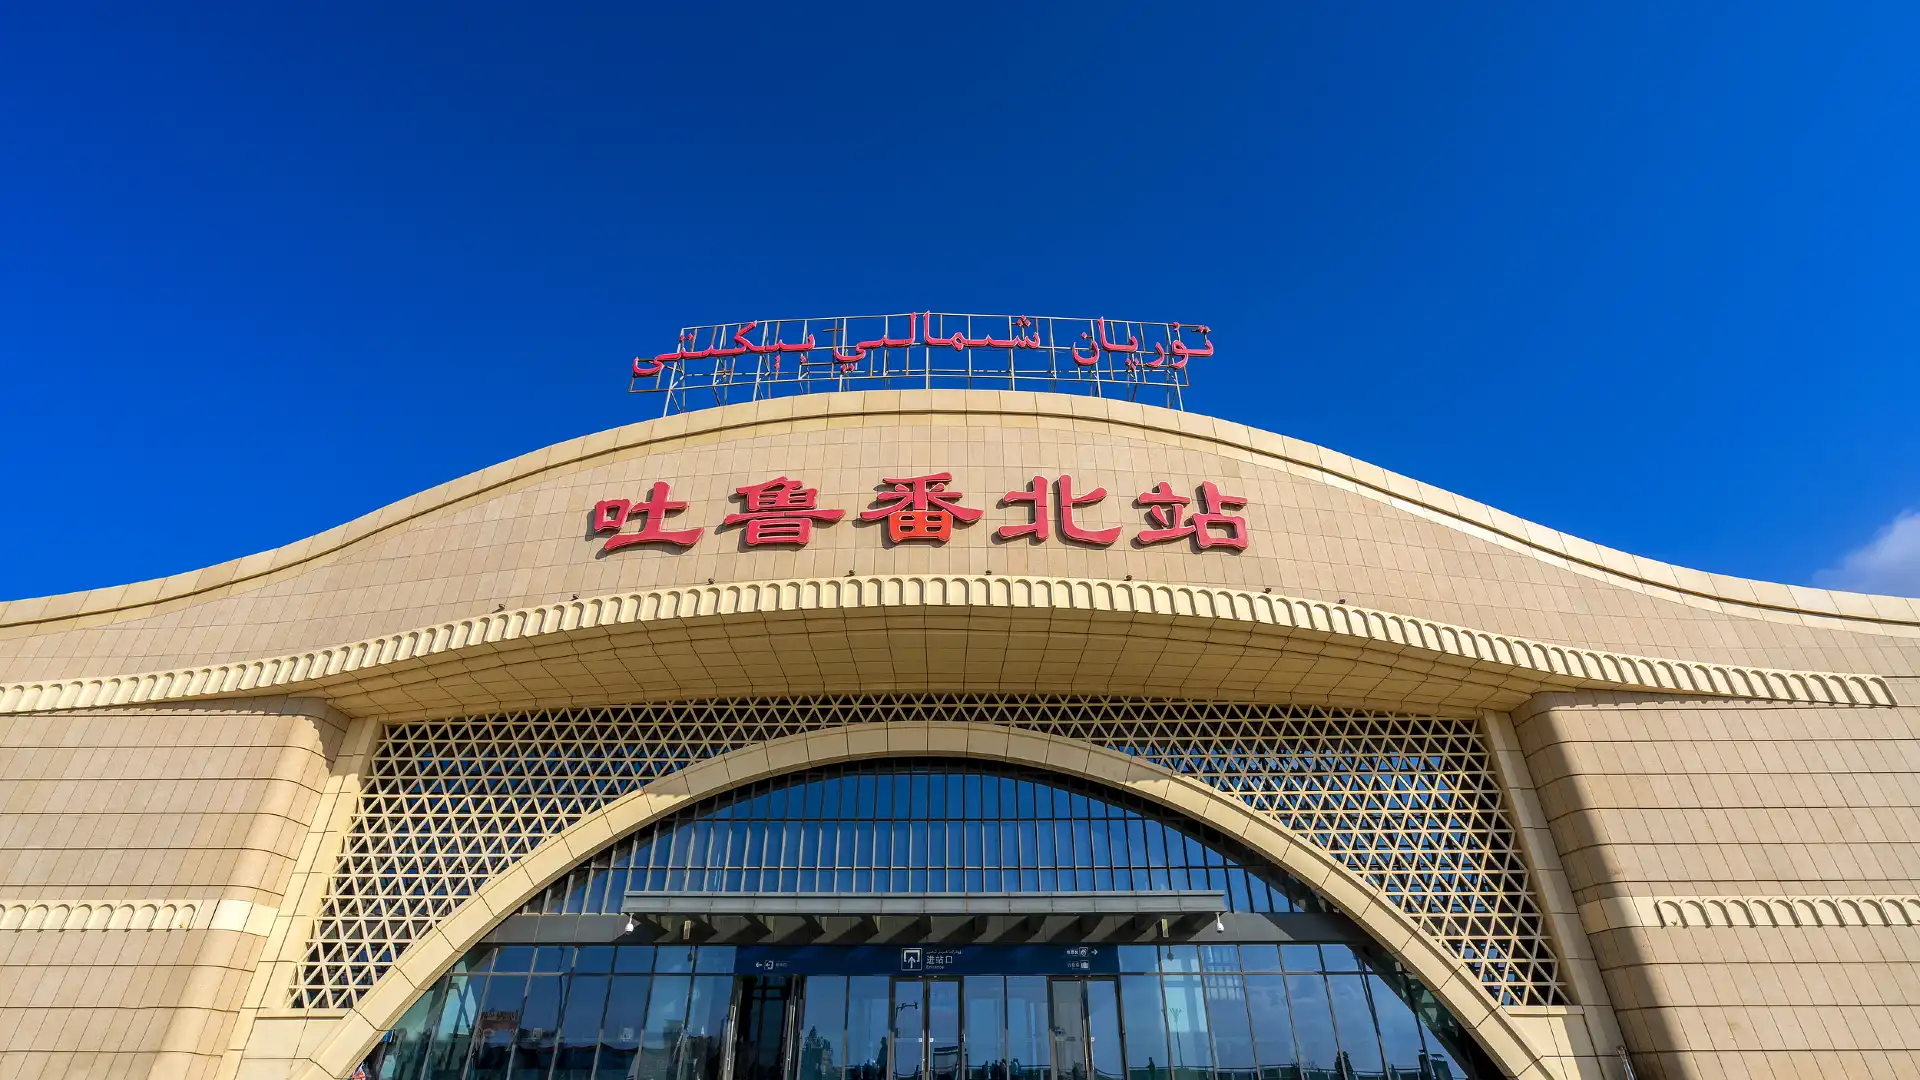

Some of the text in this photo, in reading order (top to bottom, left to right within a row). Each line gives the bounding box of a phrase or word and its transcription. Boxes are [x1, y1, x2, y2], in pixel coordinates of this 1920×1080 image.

[592, 472, 1249, 551] 吐鲁番北站
[926, 955, 953, 965] 进站口
